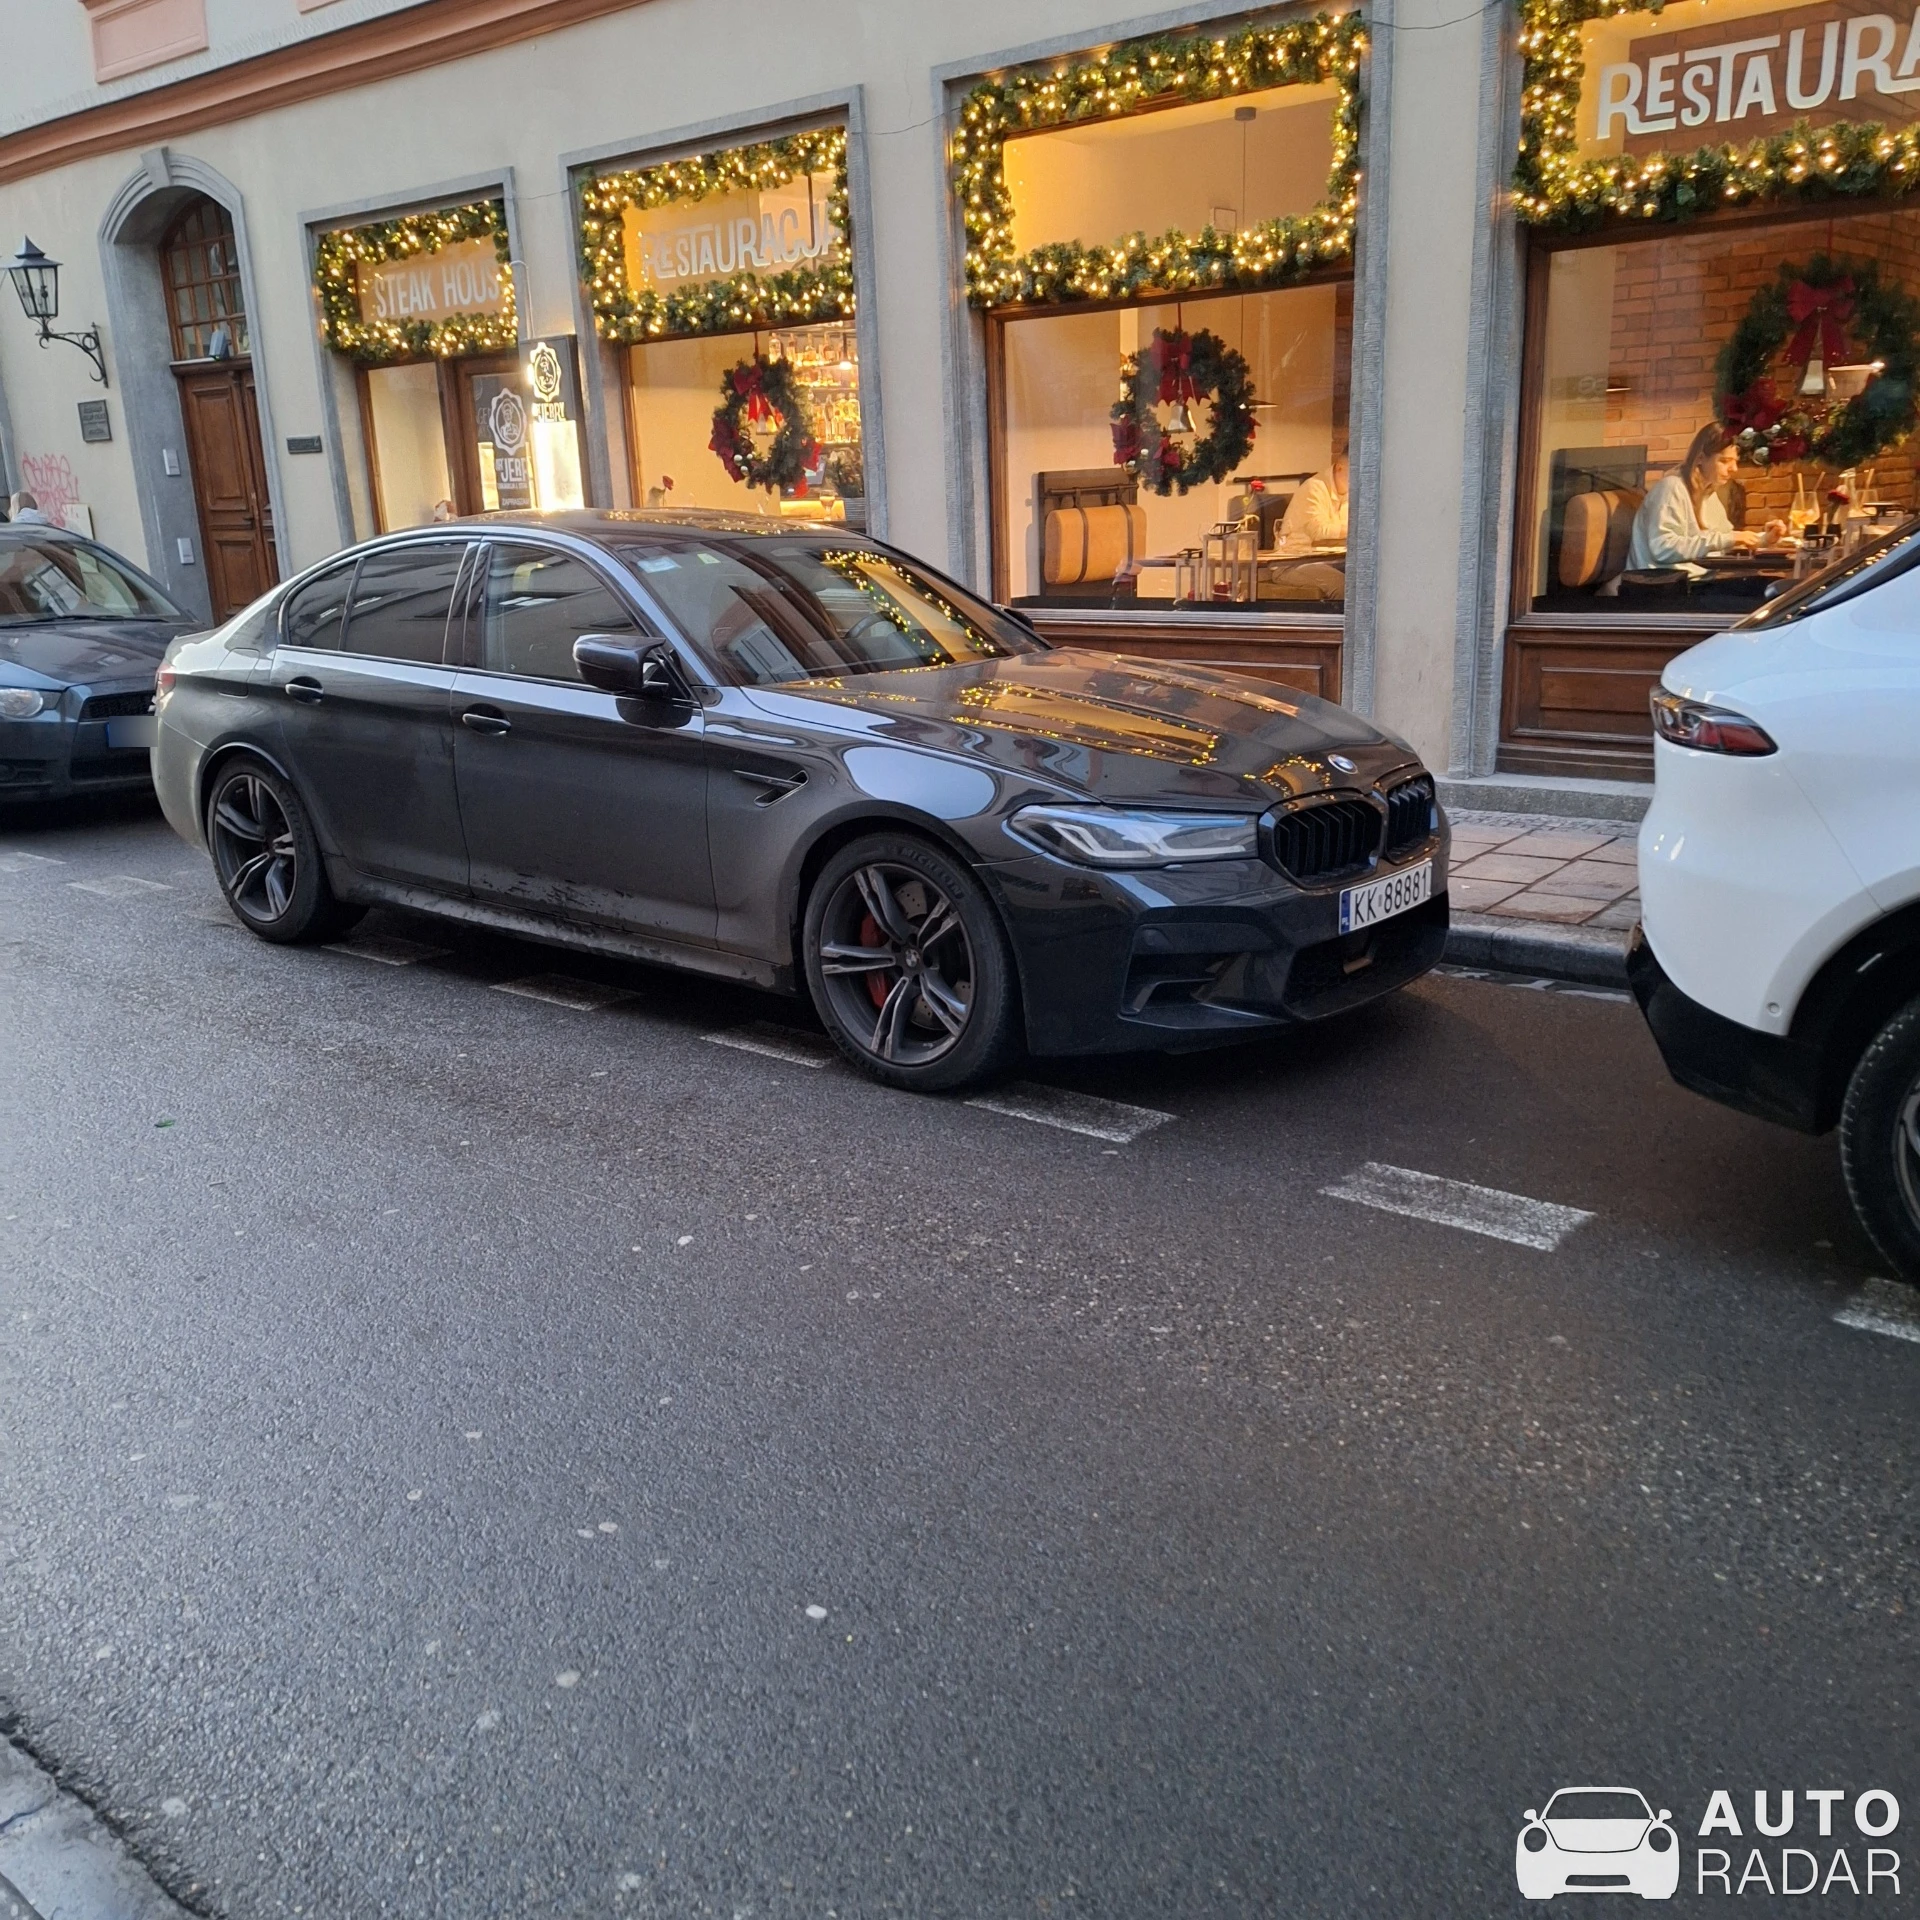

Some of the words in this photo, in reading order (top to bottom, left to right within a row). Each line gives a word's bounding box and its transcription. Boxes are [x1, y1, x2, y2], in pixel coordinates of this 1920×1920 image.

[374, 268, 436, 319] STEAK
[442, 256, 501, 308] HOUS
[501, 457, 528, 482] JER
[1354, 886, 1378, 925] KK
[1383, 867, 1427, 914] 88881
